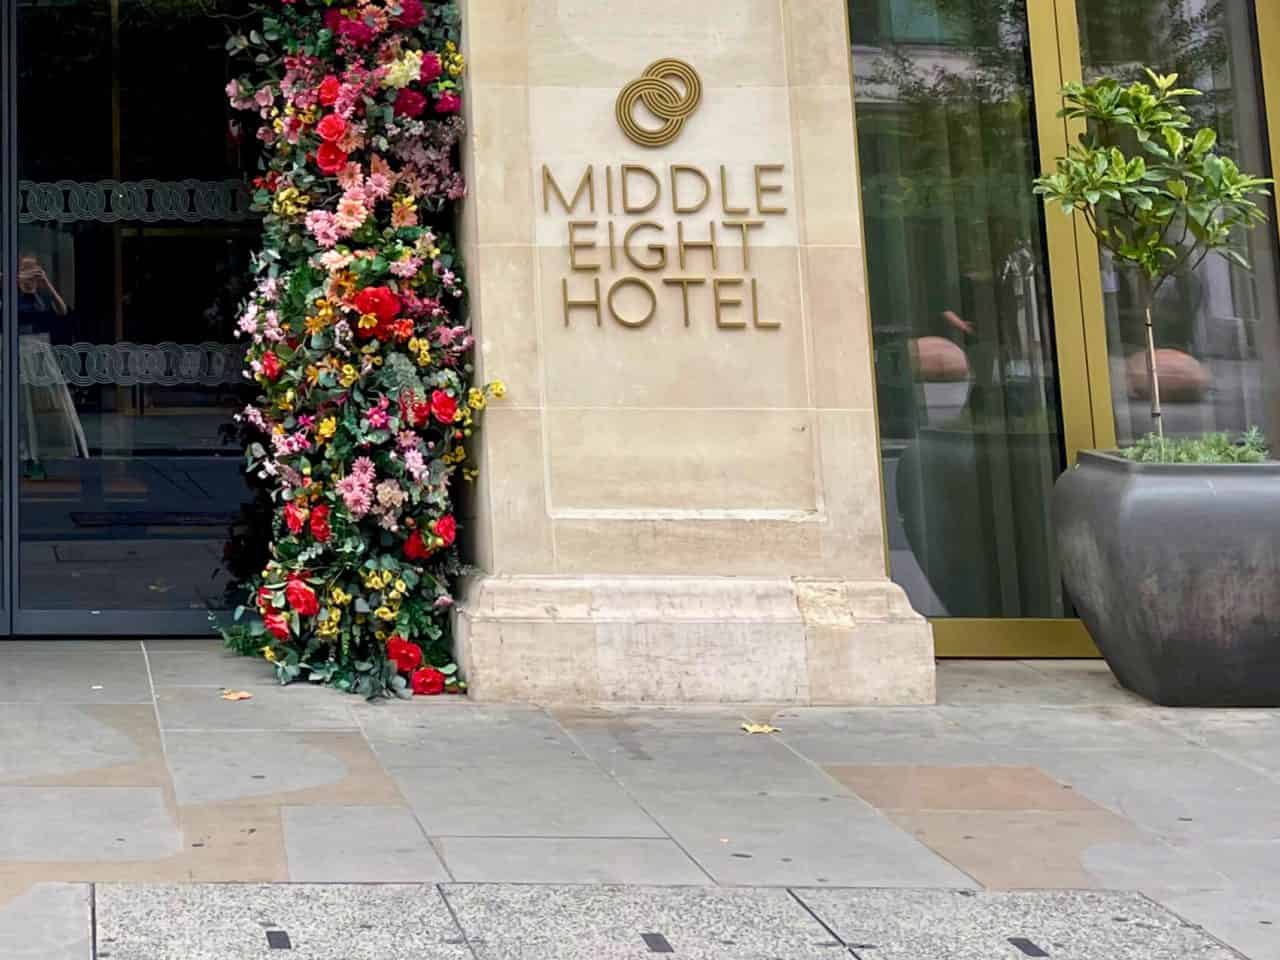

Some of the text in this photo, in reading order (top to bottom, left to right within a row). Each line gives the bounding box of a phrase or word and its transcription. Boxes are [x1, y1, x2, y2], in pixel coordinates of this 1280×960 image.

[542, 164, 788, 215] MIDDLE
[568, 221, 765, 271] EIGHT
[561, 276, 781, 329] HOTEL
